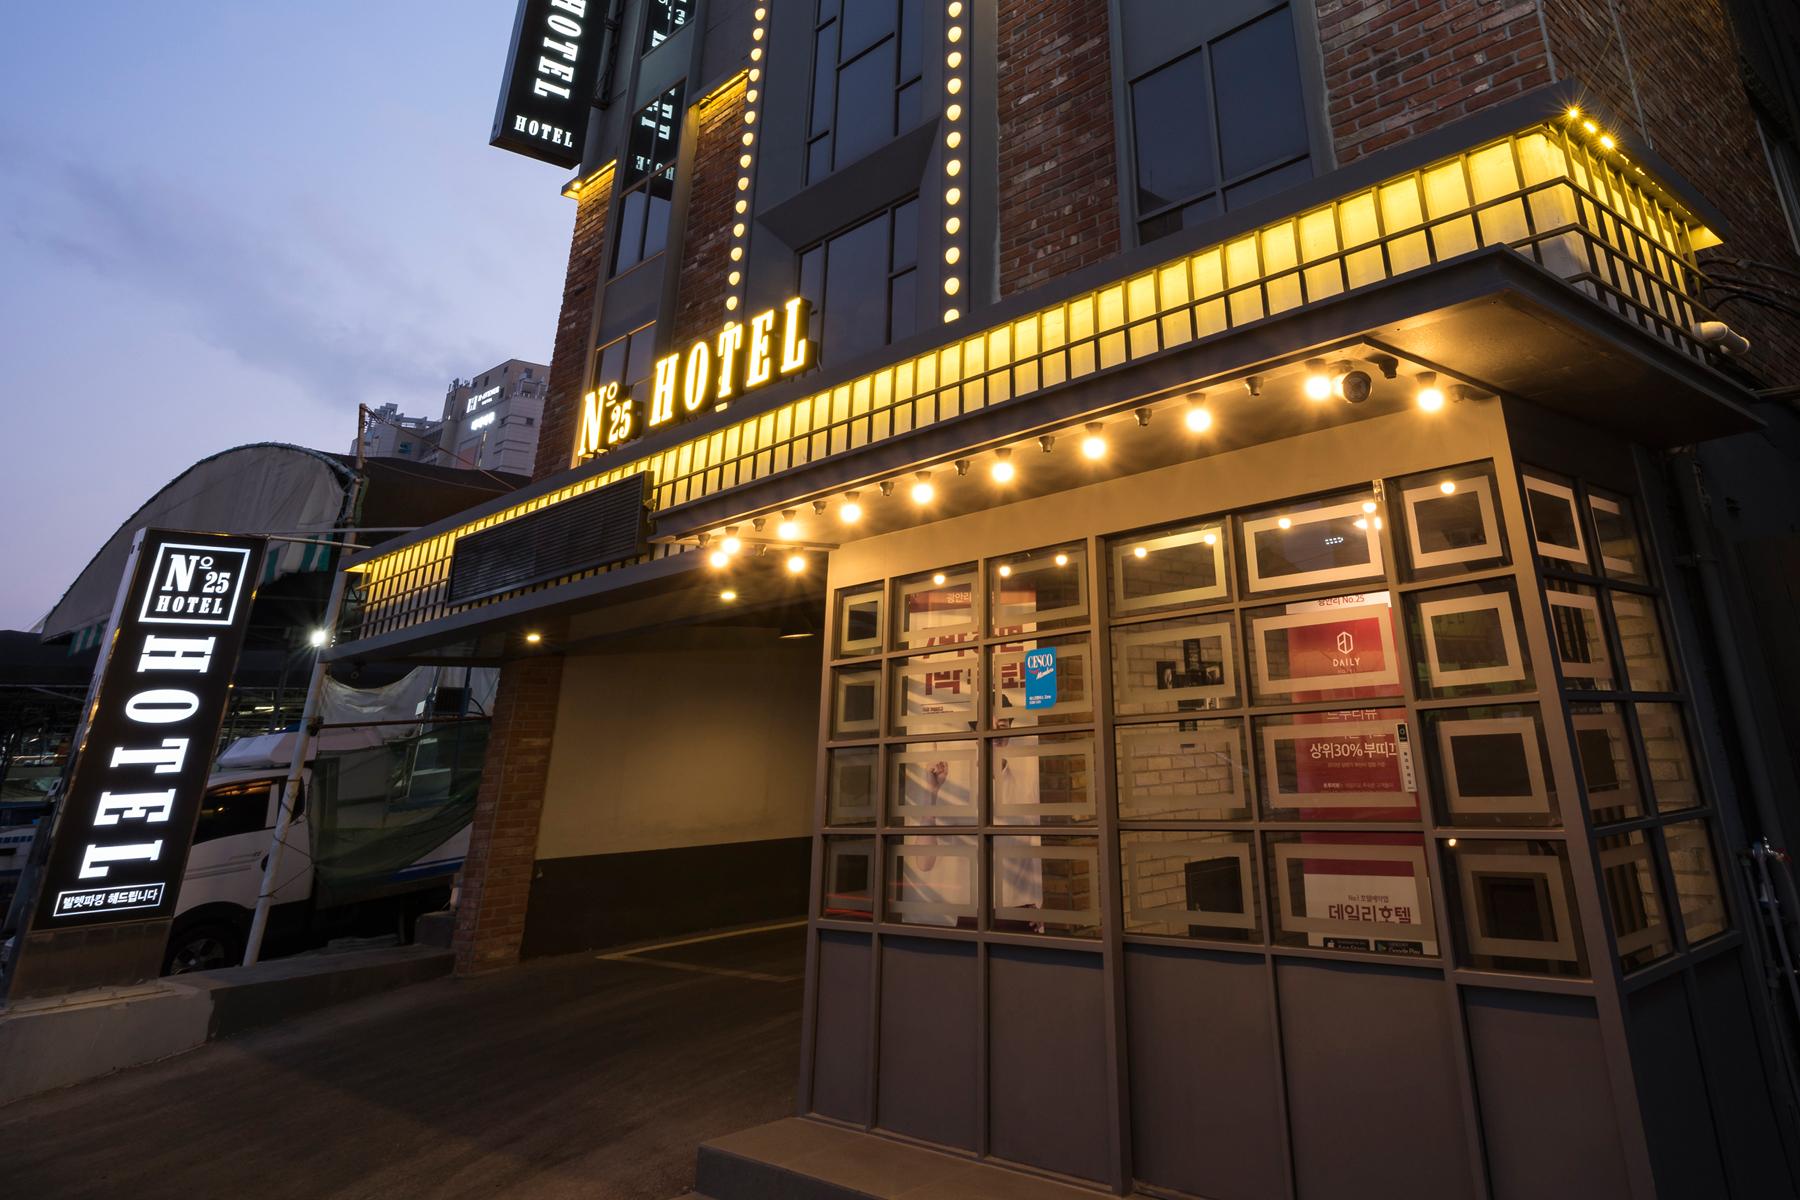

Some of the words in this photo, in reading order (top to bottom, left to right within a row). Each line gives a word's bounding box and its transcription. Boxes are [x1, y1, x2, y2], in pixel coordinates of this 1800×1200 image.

[514, 115, 573, 148] HOTEL
[608, 399, 632, 445] 25
[649, 296, 807, 427] HOTEL
[202, 571, 231, 594] 25
[155, 595, 223, 615] HOTEL
[1027, 653, 1053, 669] CESCO
[1332, 657, 1360, 667] DAILY
[78, 634, 216, 880] HOTEL
[1310, 742, 1363, 760] 상위30%
